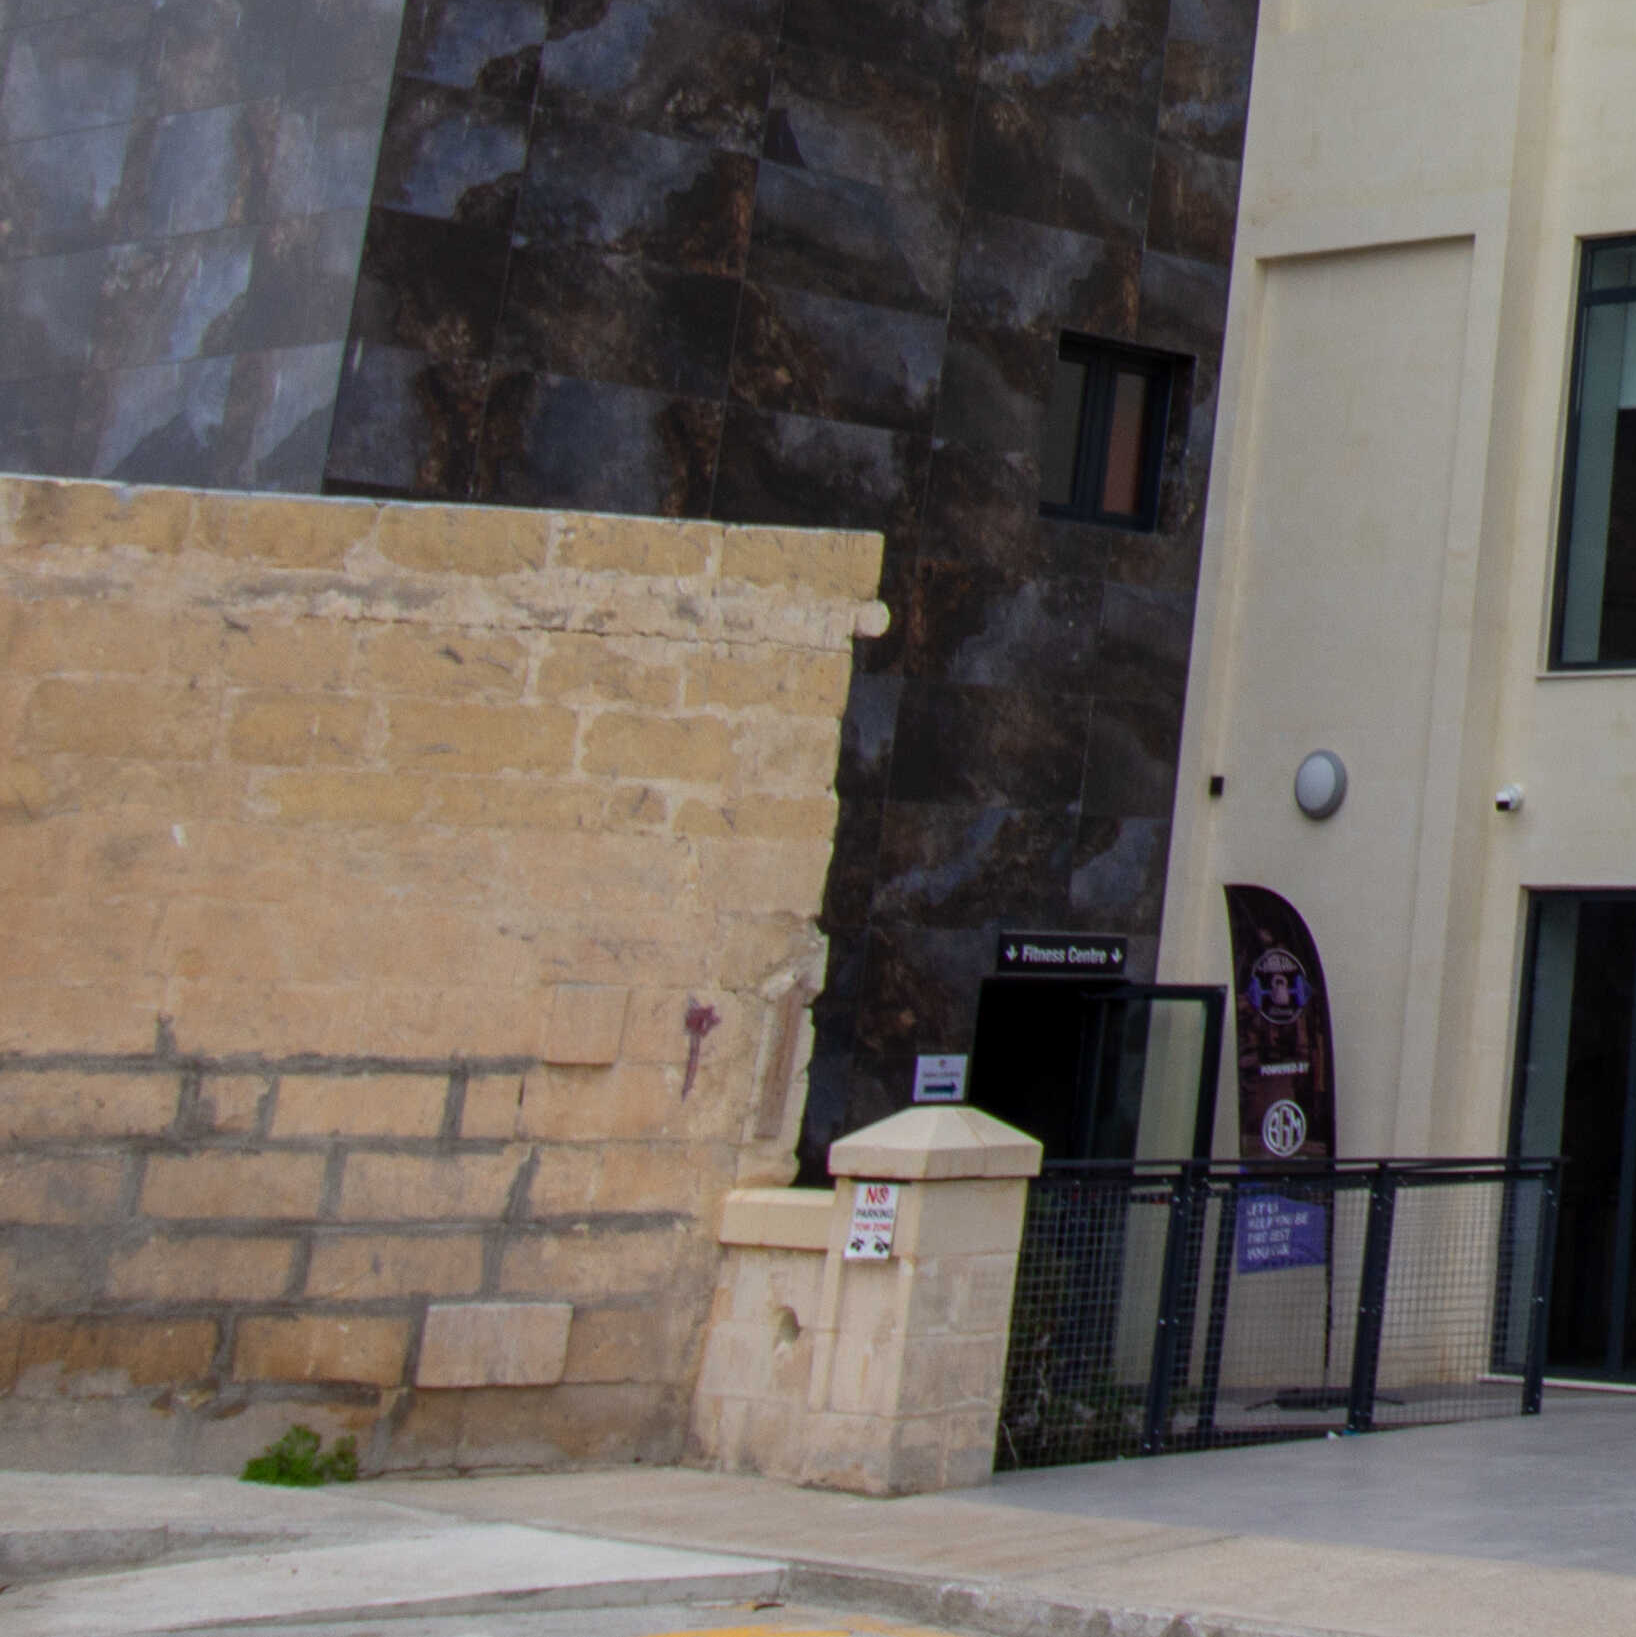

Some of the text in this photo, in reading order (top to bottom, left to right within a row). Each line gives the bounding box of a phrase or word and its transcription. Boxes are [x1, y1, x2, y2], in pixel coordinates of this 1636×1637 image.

[1021, 943, 1107, 964] Fitness Centre
[856, 1208, 894, 1220] PARKING
